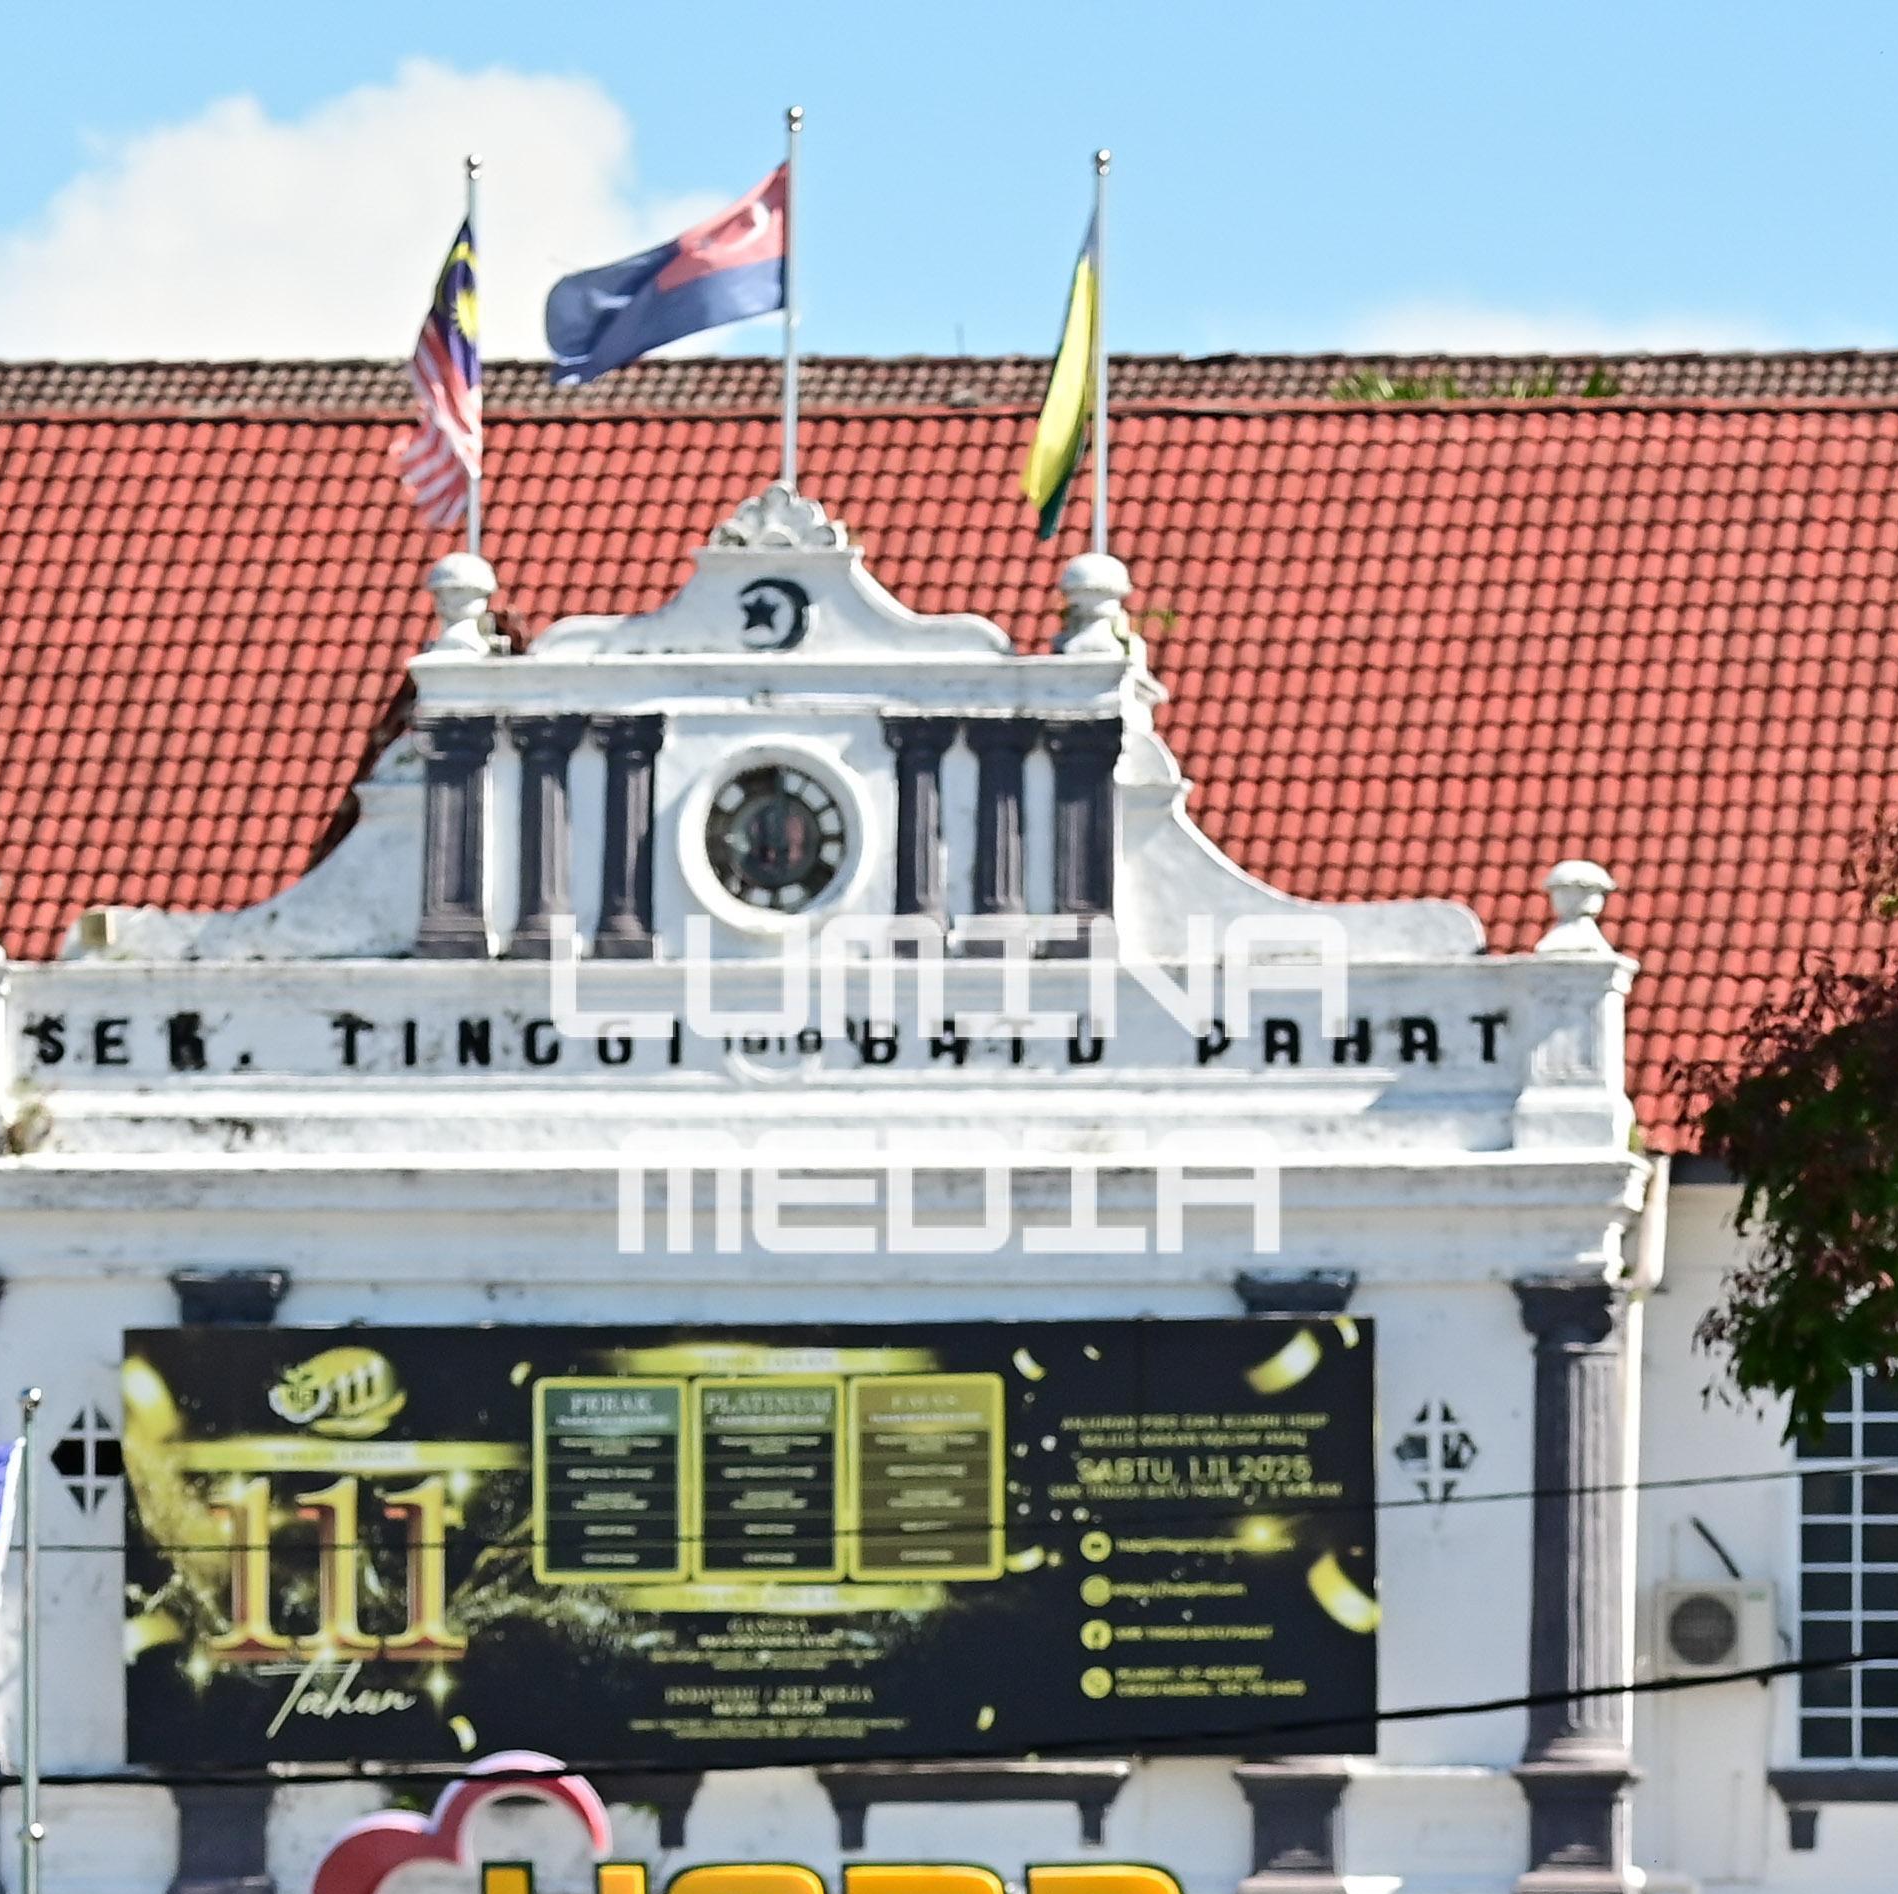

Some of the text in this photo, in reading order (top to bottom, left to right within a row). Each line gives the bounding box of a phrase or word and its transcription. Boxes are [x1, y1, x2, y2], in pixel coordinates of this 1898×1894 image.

[332, 1015, 682, 1066] TINGGI
[854, 1011, 1510, 1065] BATU PAHAT
[205, 1475, 469, 1662] 111
